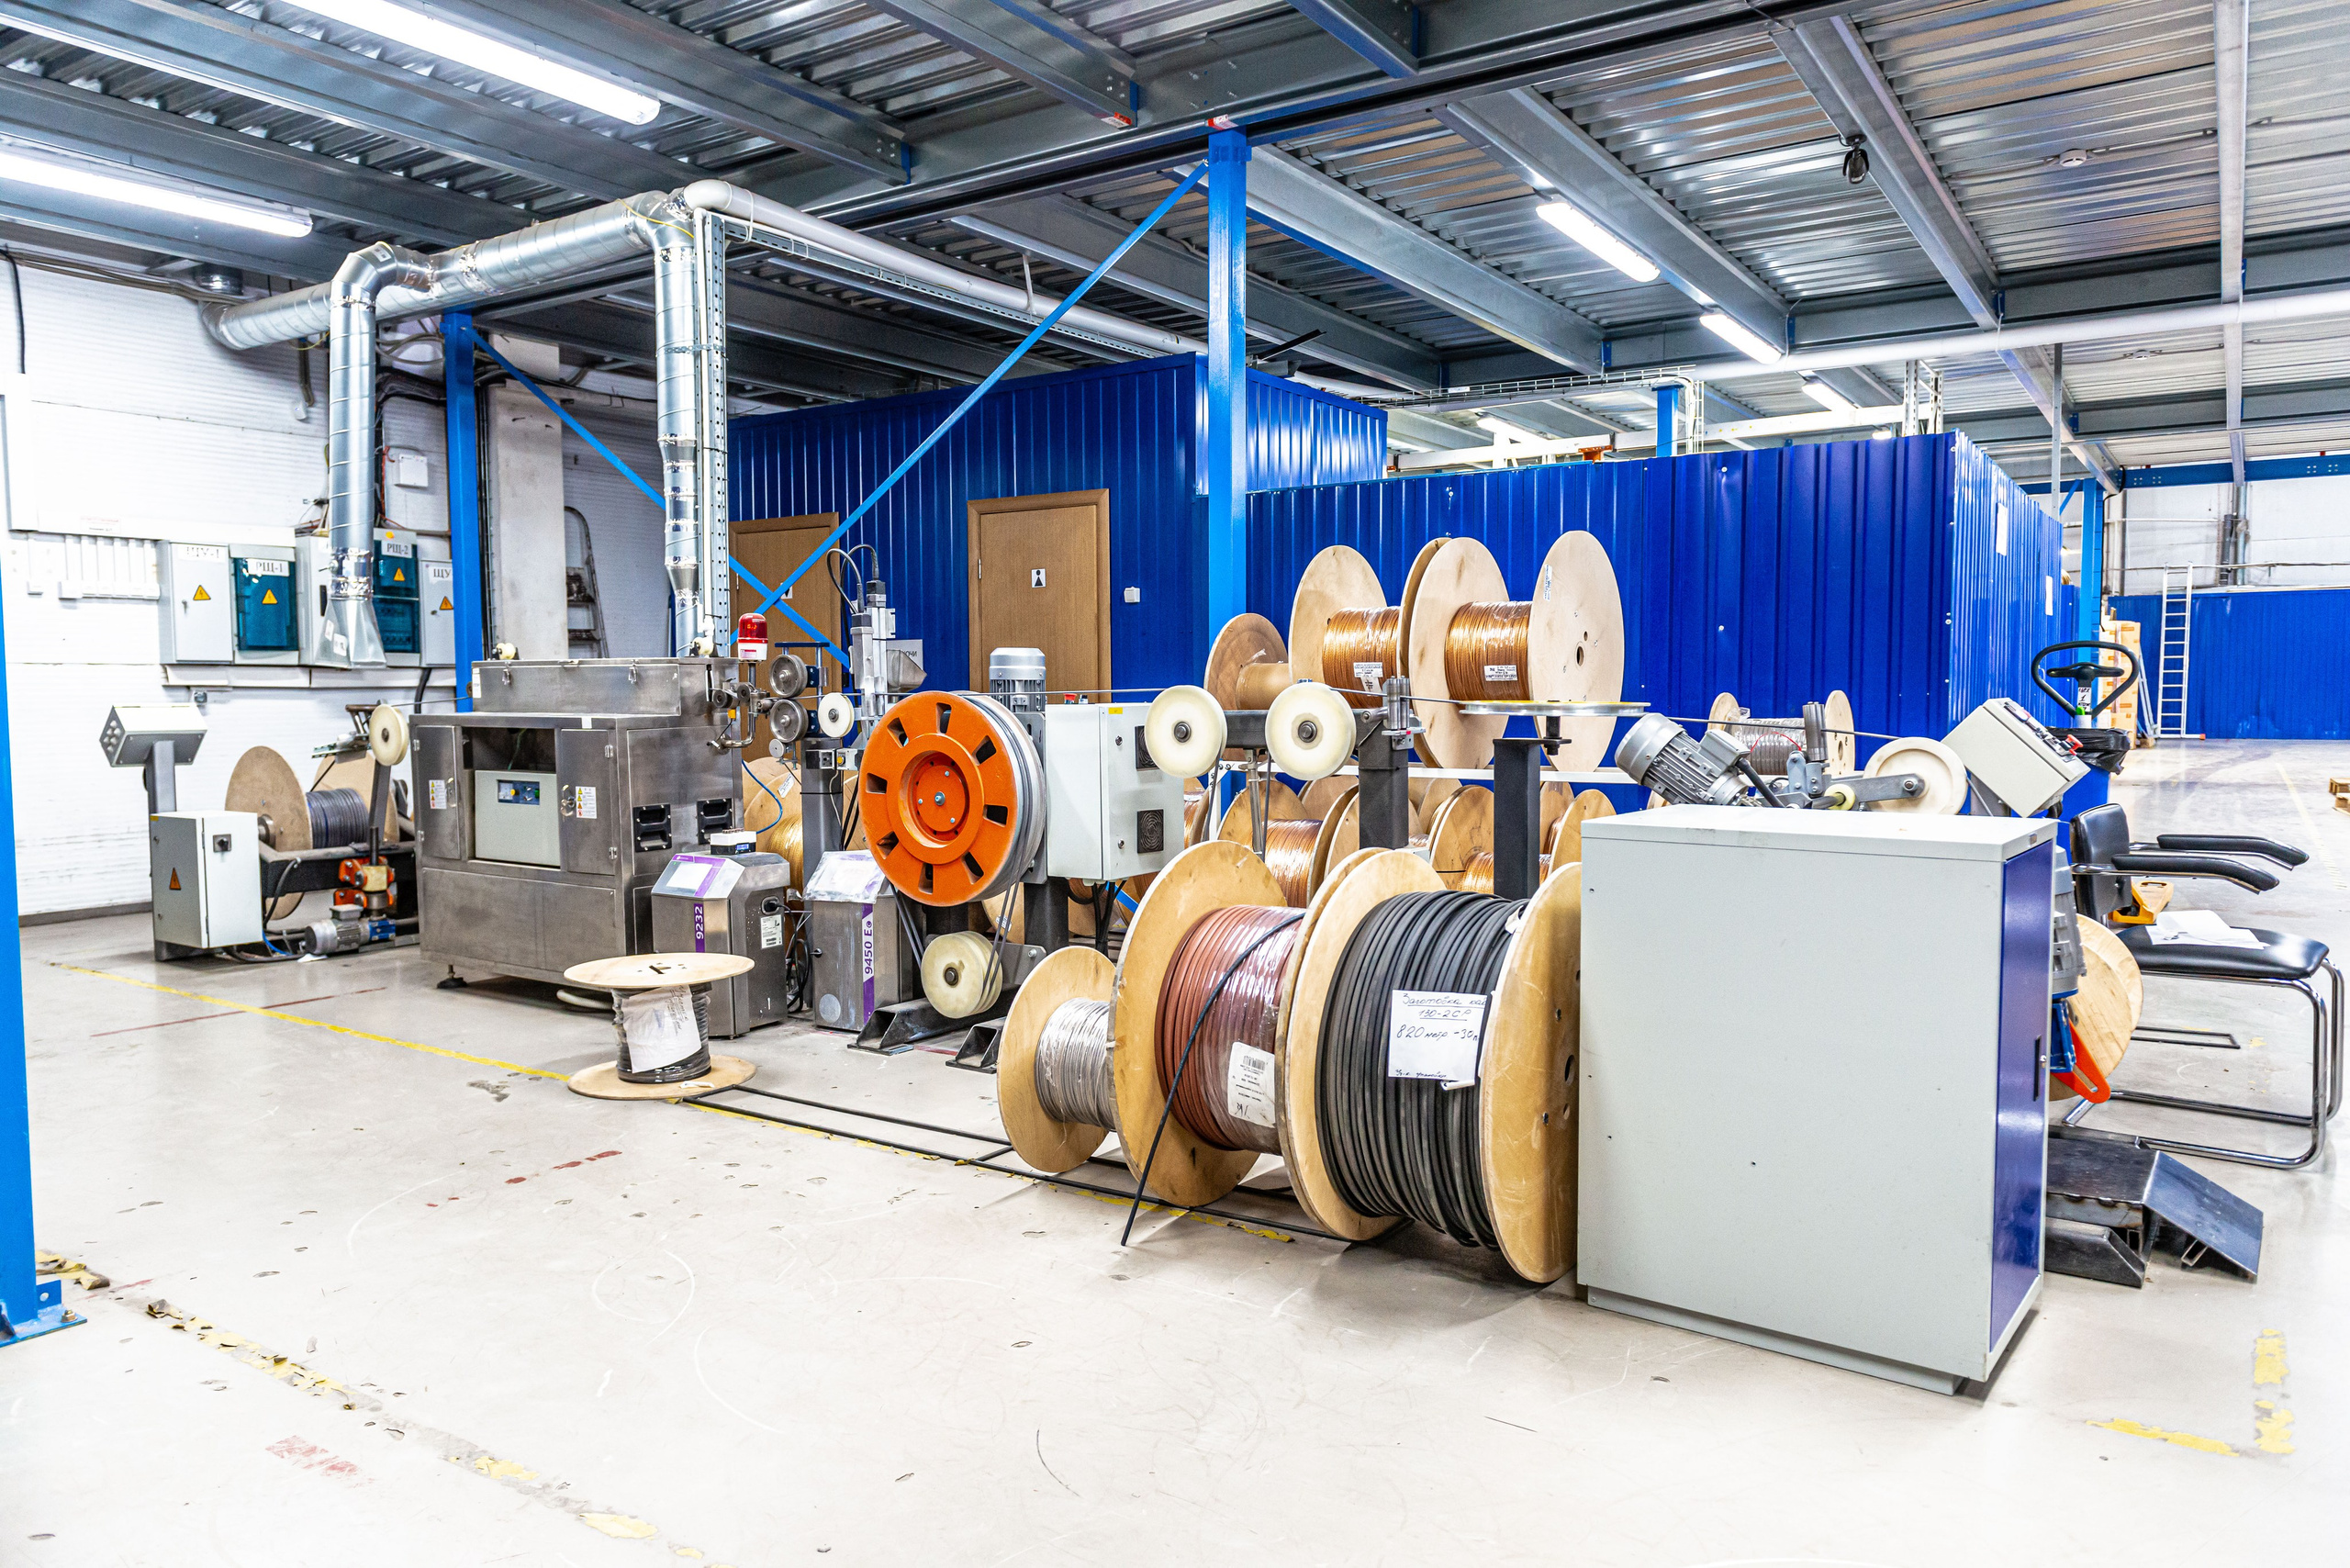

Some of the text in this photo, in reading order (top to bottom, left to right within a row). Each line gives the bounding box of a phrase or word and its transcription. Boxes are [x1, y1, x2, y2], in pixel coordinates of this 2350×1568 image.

[386, 543, 408, 555] РЩ-2
[694, 905, 704, 940] 9232
[864, 941, 873, 975] 9450
[1396, 1024, 1425, 1038] 820
